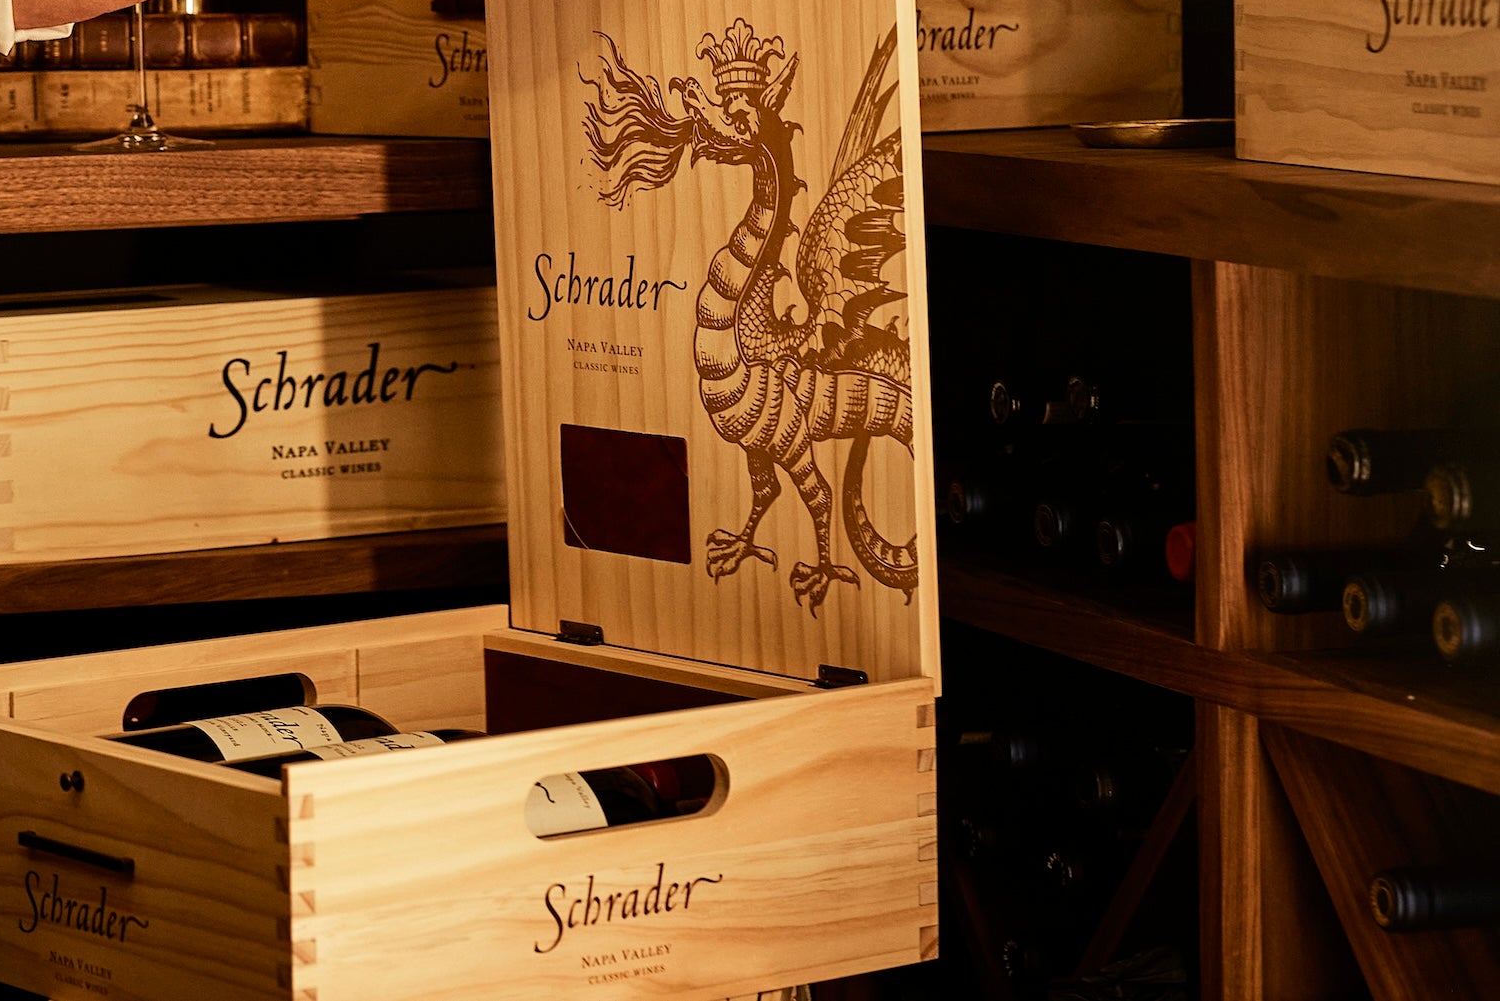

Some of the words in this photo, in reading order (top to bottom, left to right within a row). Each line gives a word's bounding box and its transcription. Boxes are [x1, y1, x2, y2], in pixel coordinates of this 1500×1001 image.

[916, 7, 1019, 52] hrader
[429, 31, 488, 89] Schr
[920, 77, 939, 87] APA
[528, 252, 687, 321] Schrader
[567, 338, 597, 353] NAPA
[601, 341, 644, 358] VALLEY
[573, 361, 608, 372] CLASSIC
[611, 365, 639, 375] WINES
[209, 342, 458, 439] Schrader
[271, 446, 318, 460] NAPA
[324, 438, 390, 455] VALLEY
[281, 466, 335, 480] CLASSIC
[340, 462, 381, 474] WINES
[316, 723, 332, 742] Napa
[19, 871, 149, 942] Schrader
[534, 862, 723, 953] Schrader
[581, 953, 617, 969] NAPA
[621, 943, 672, 961] VALLEY
[588, 971, 630, 985] CLASSIC
[634, 964, 666, 977] WINES
